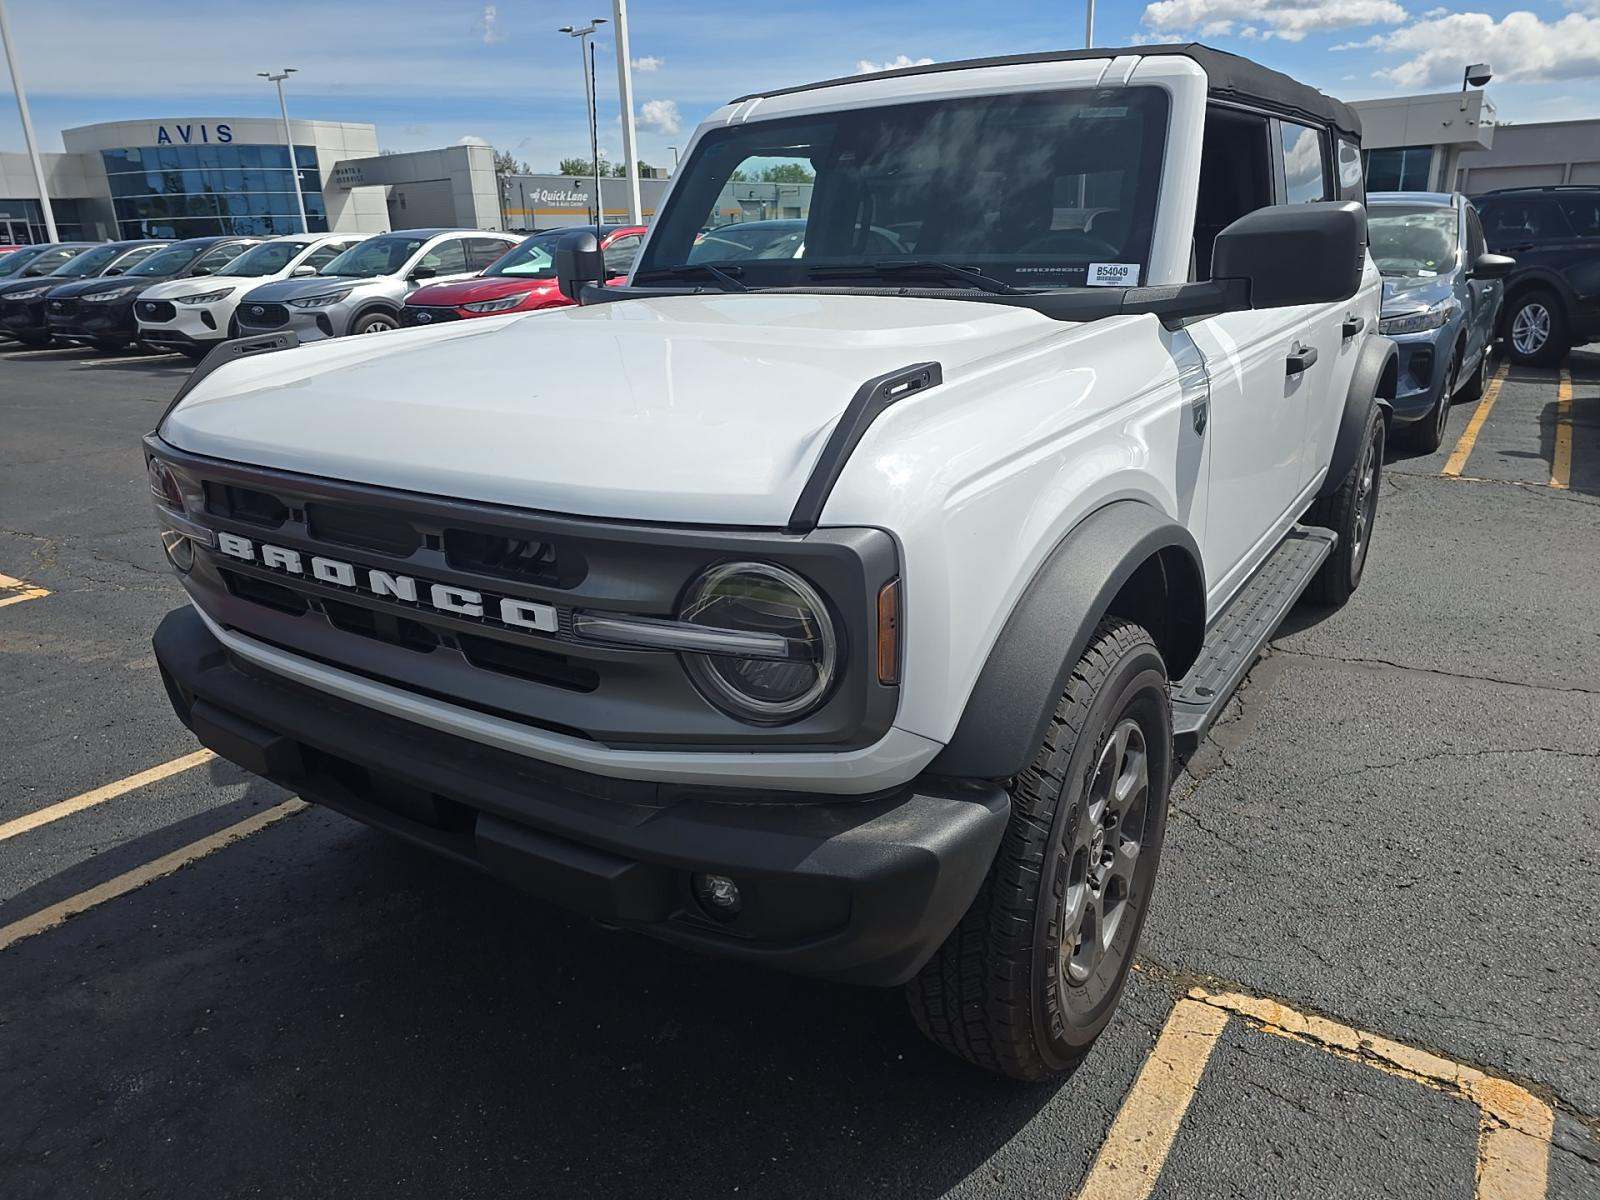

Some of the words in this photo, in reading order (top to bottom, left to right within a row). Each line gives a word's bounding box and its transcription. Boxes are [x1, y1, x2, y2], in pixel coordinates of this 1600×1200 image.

[157, 124, 233, 144] AVIS
[541, 190, 565, 202] Quick
[567, 191, 588, 201] Lane
[1096, 266, 1128, 276] B54049
[218, 532, 559, 632] BRONCO
